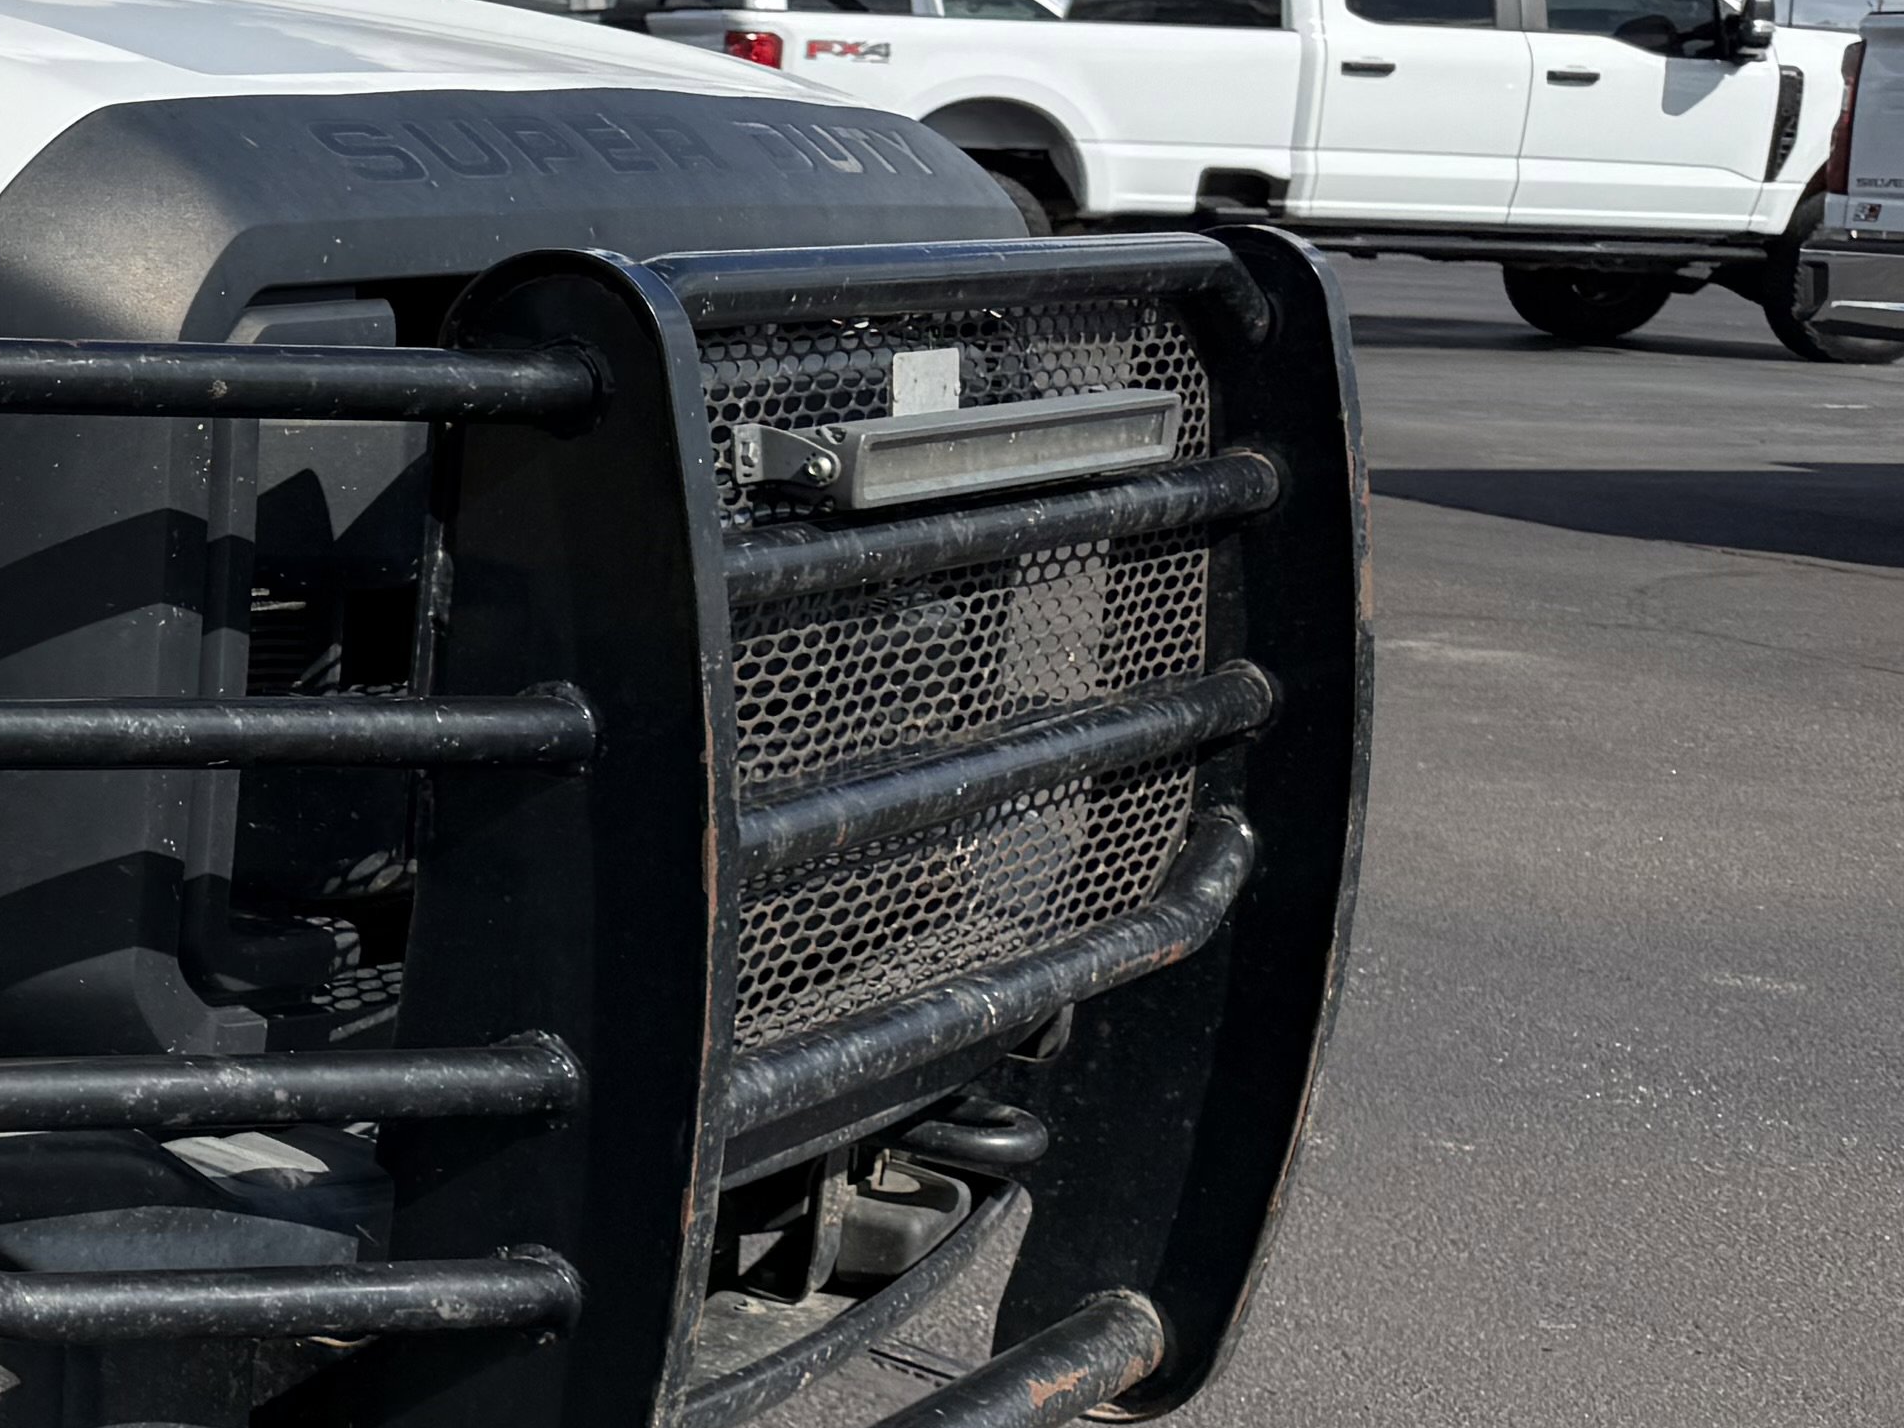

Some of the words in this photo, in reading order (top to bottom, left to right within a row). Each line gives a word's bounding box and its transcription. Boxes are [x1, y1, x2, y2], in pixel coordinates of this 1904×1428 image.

[805, 39, 891, 64] FX4
[306, 113, 726, 182] SUPER
[730, 120, 935, 179] DUTY
